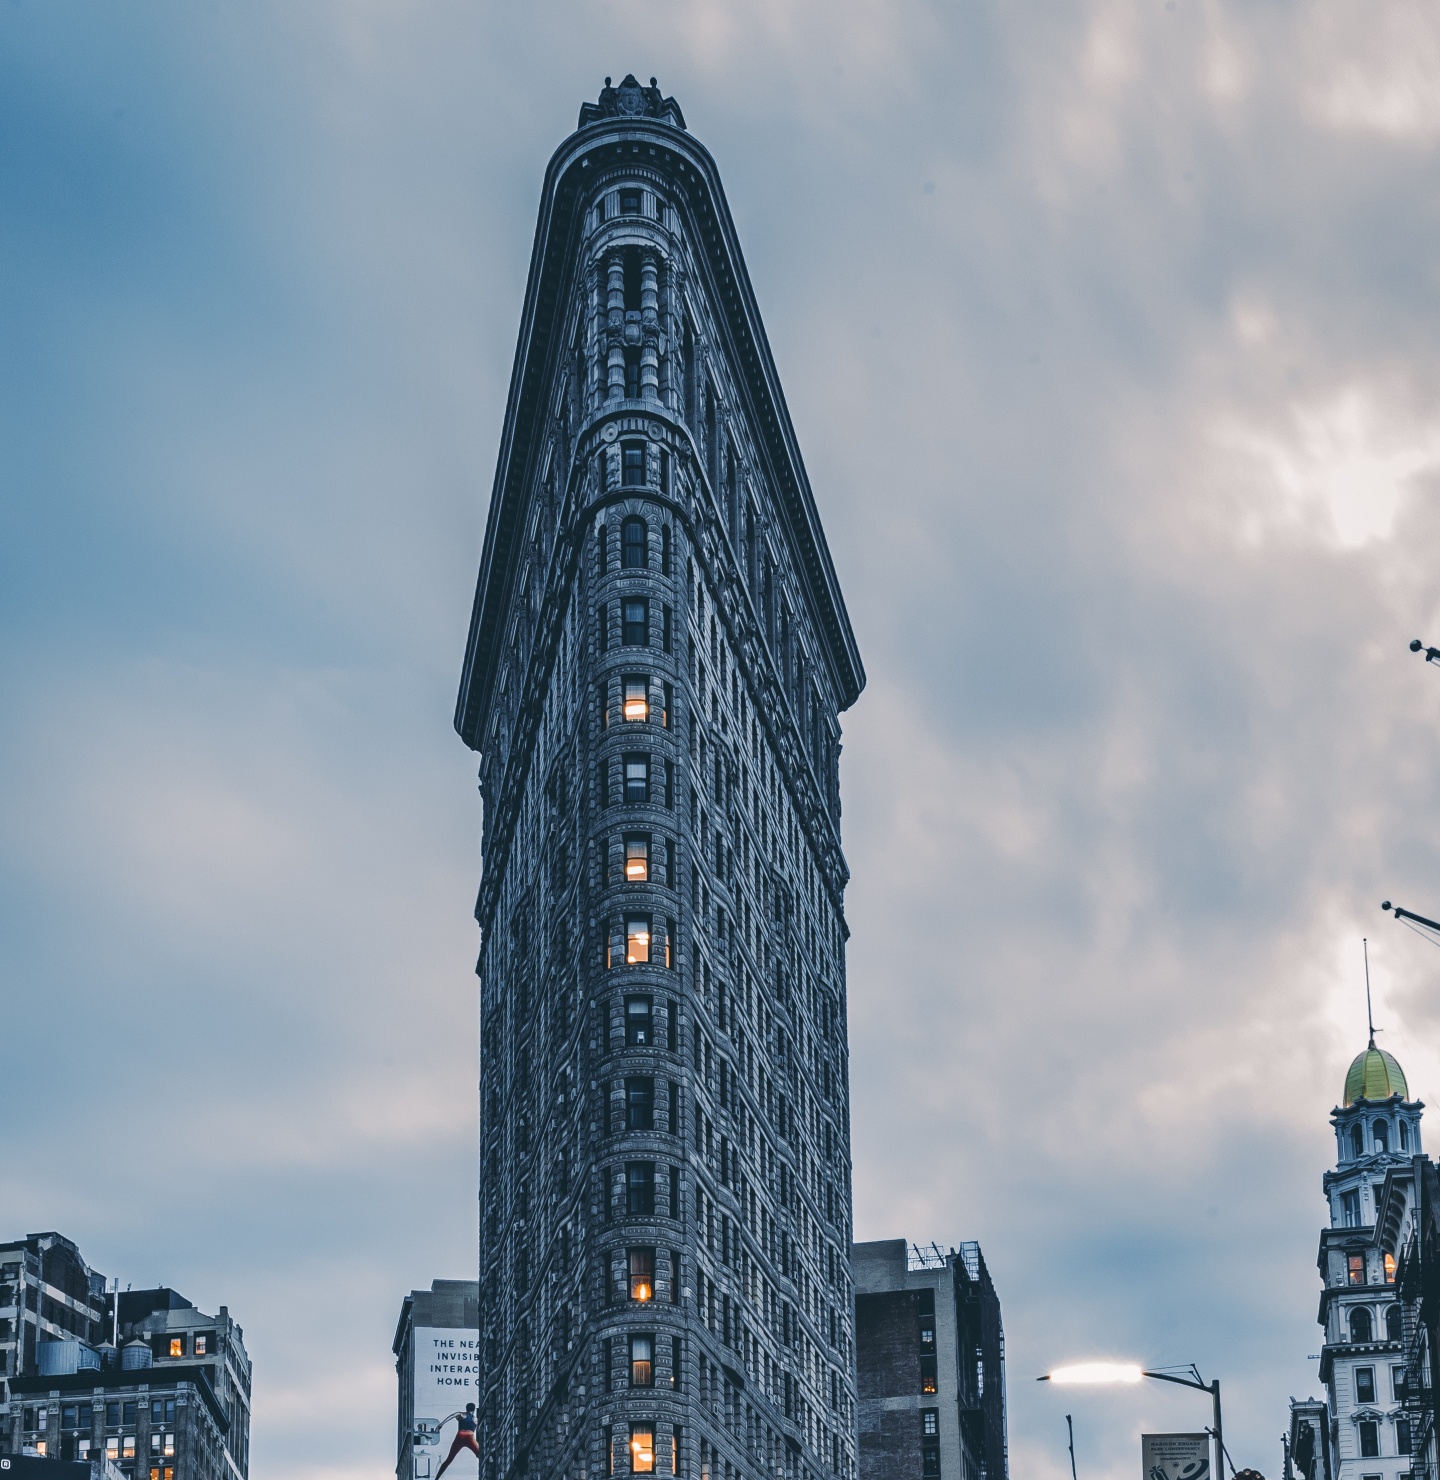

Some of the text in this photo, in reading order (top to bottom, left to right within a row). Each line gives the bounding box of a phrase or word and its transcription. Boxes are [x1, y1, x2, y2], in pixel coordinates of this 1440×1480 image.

[437, 1352, 479, 1360] INVISIB
[431, 1364, 478, 1373] INTERAC
[437, 1377, 469, 1386] HOME
